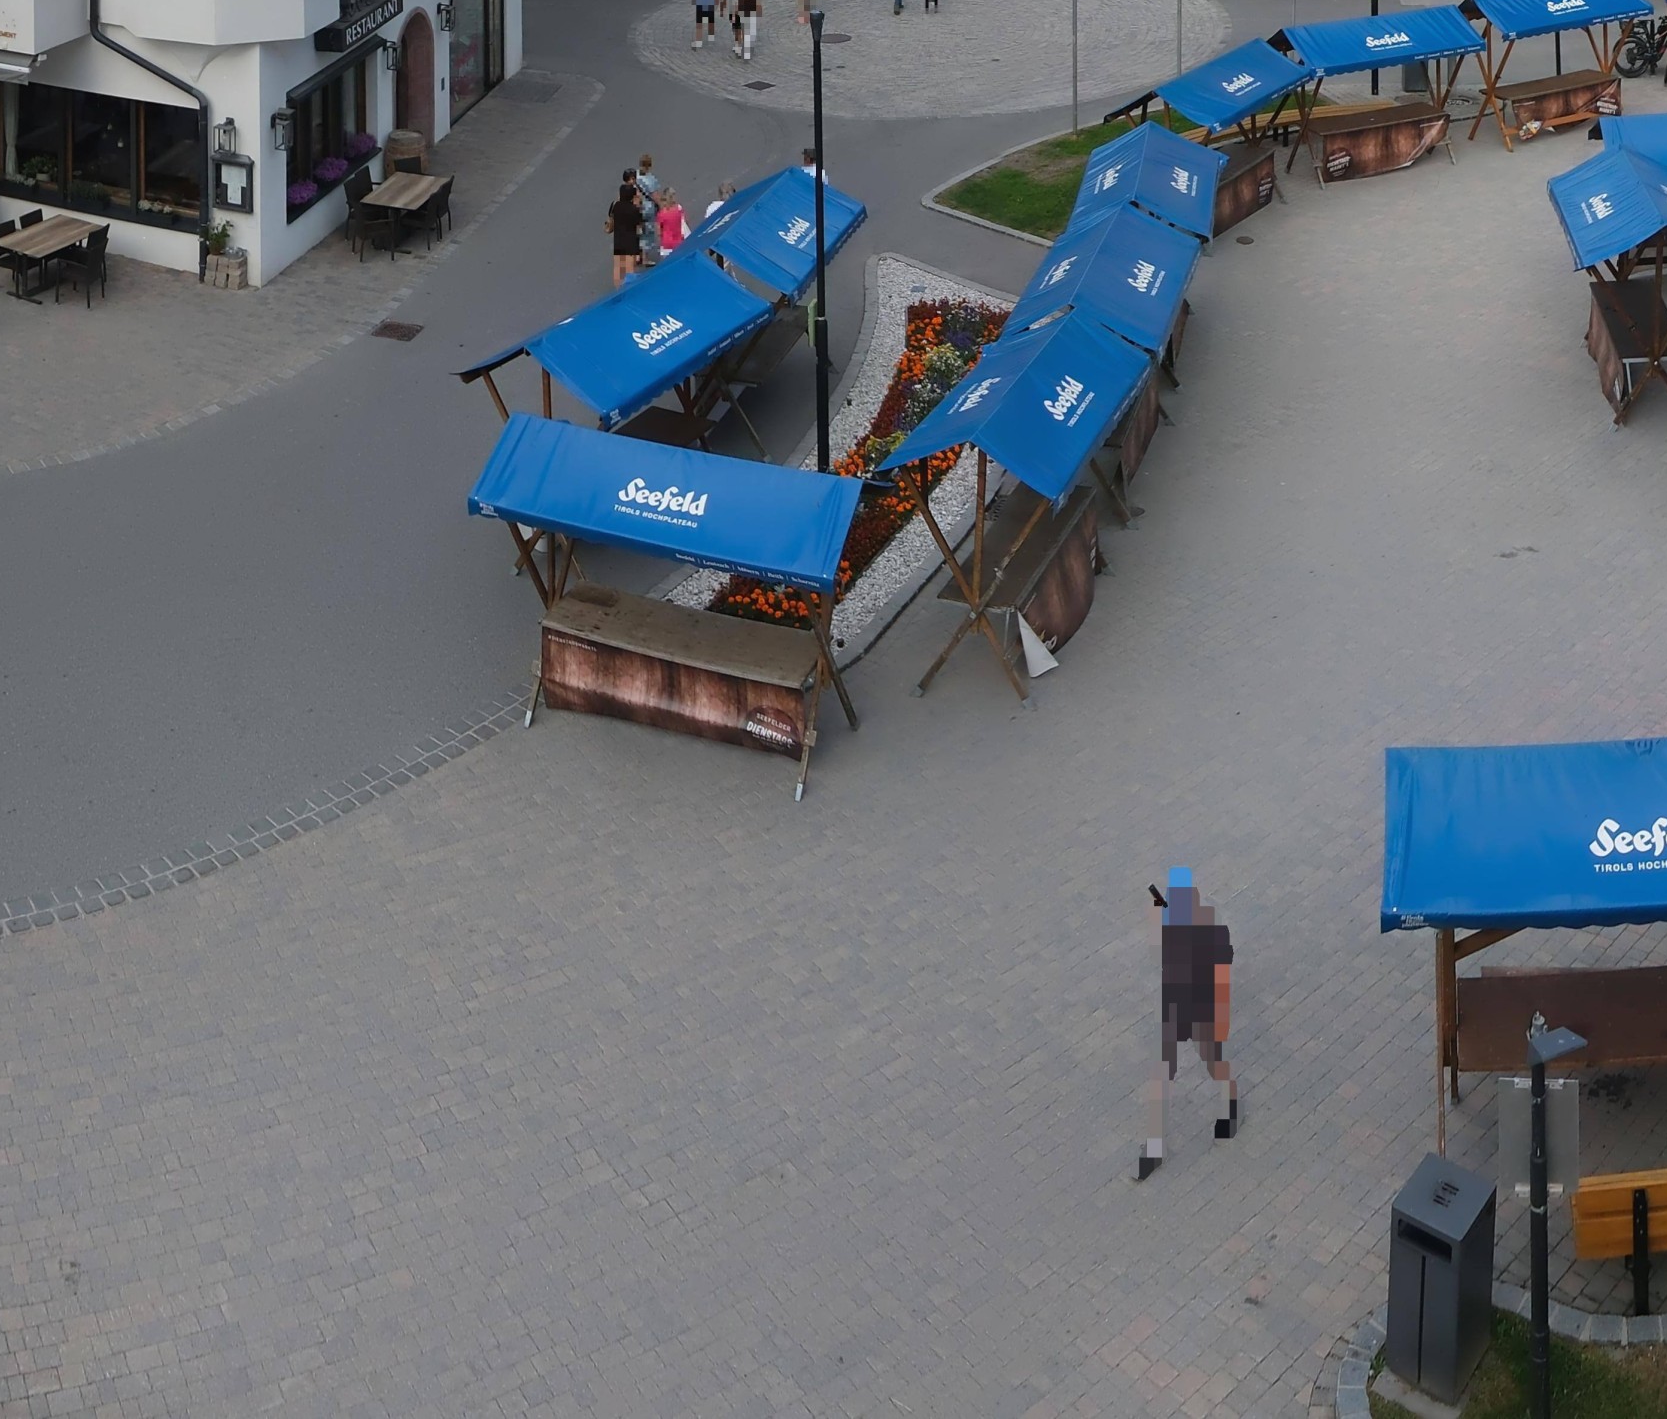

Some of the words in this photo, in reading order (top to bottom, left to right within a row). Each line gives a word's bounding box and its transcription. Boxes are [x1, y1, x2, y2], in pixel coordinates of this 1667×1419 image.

[1365, 32, 1409, 48] Seefeld
[778, 216, 811, 245] Seefeld
[632, 314, 683, 350] Seefeld
[1044, 374, 1084, 421] Seefeld
[618, 477, 708, 517] Seefeld
[614, 504, 640, 517] TIROLS
[642, 510, 698, 528] HOCHPLATEAU
[756, 712, 792, 733] SEEFELDER
[1593, 862, 1634, 874] TIROLS
